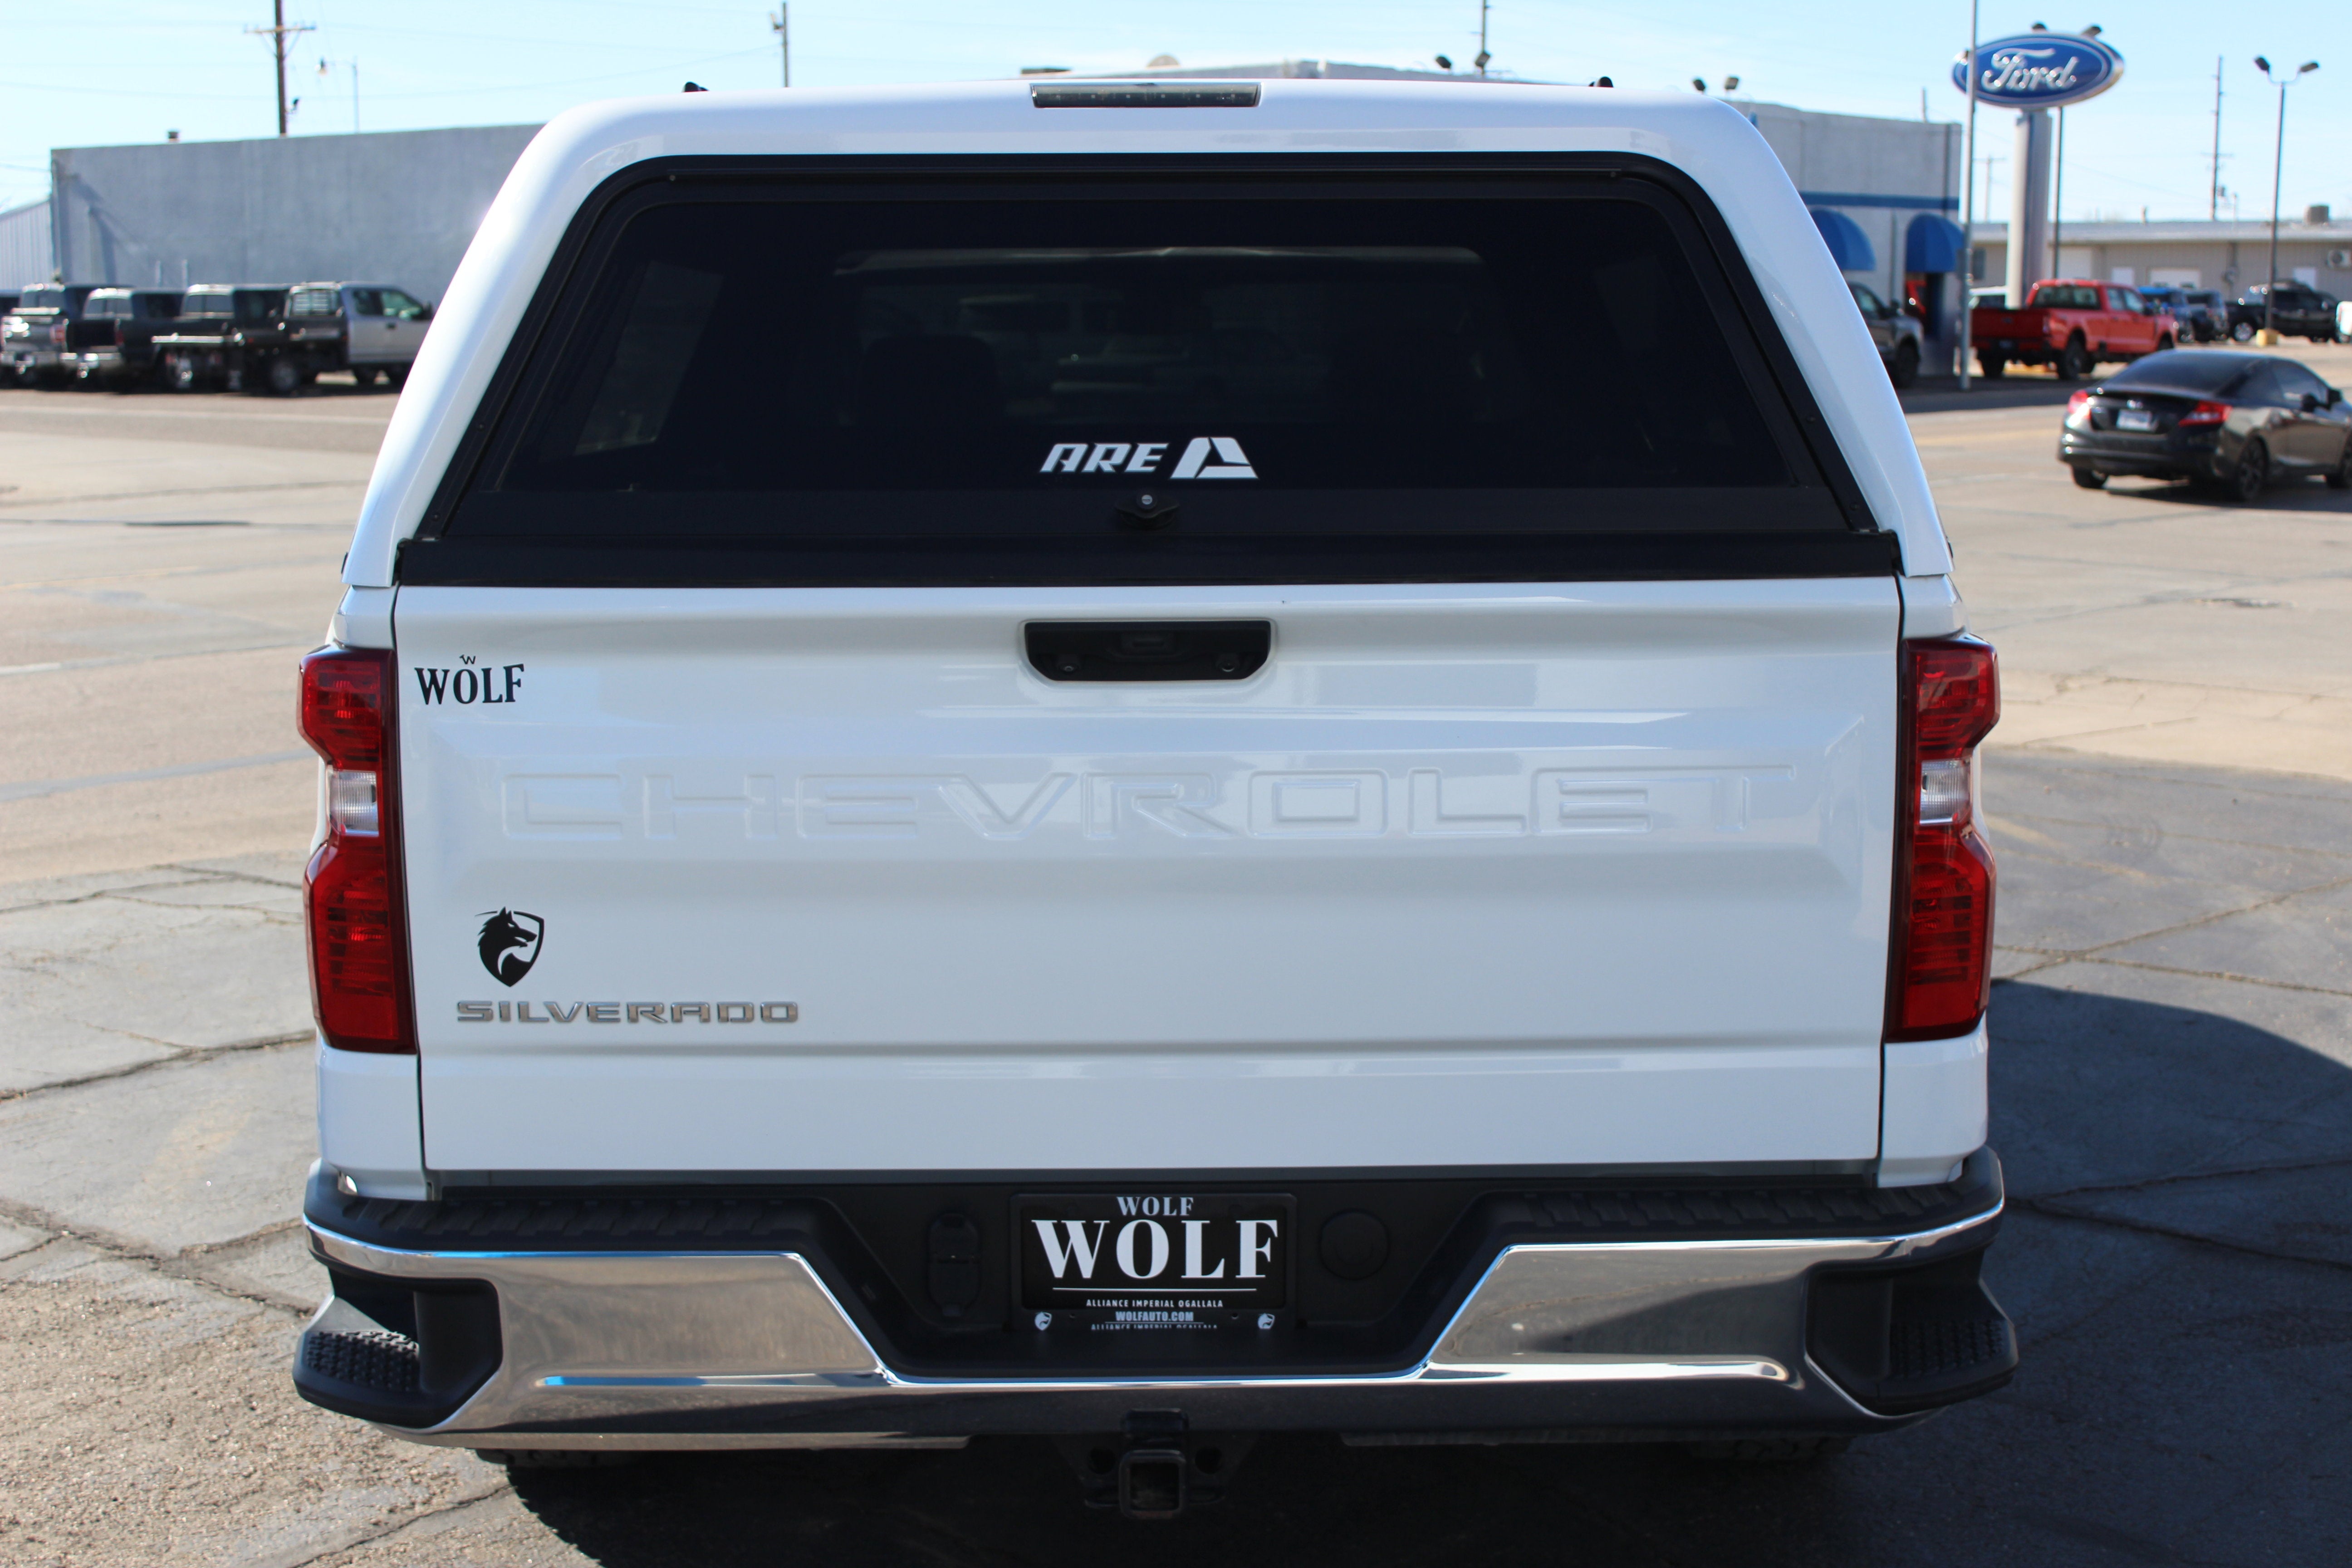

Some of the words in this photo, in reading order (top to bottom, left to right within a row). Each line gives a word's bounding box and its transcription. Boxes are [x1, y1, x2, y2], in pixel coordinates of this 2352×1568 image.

[1981, 47, 2079, 90] Ford
[1039, 442, 1169, 473] ARE
[414, 663, 524, 705] WOLF
[500, 765, 1796, 840] CHEVROLET
[457, 1000, 799, 1024] SILVERADO
[1116, 1196, 1194, 1216] WOLF
[1031, 1219, 1278, 1279] WOLF
[1086, 1299, 1129, 1307] ALLIANCE
[1132, 1299, 1174, 1308] IMPERIAL
[1115, 1311, 1194, 1322] WOLFAUTO.COM
